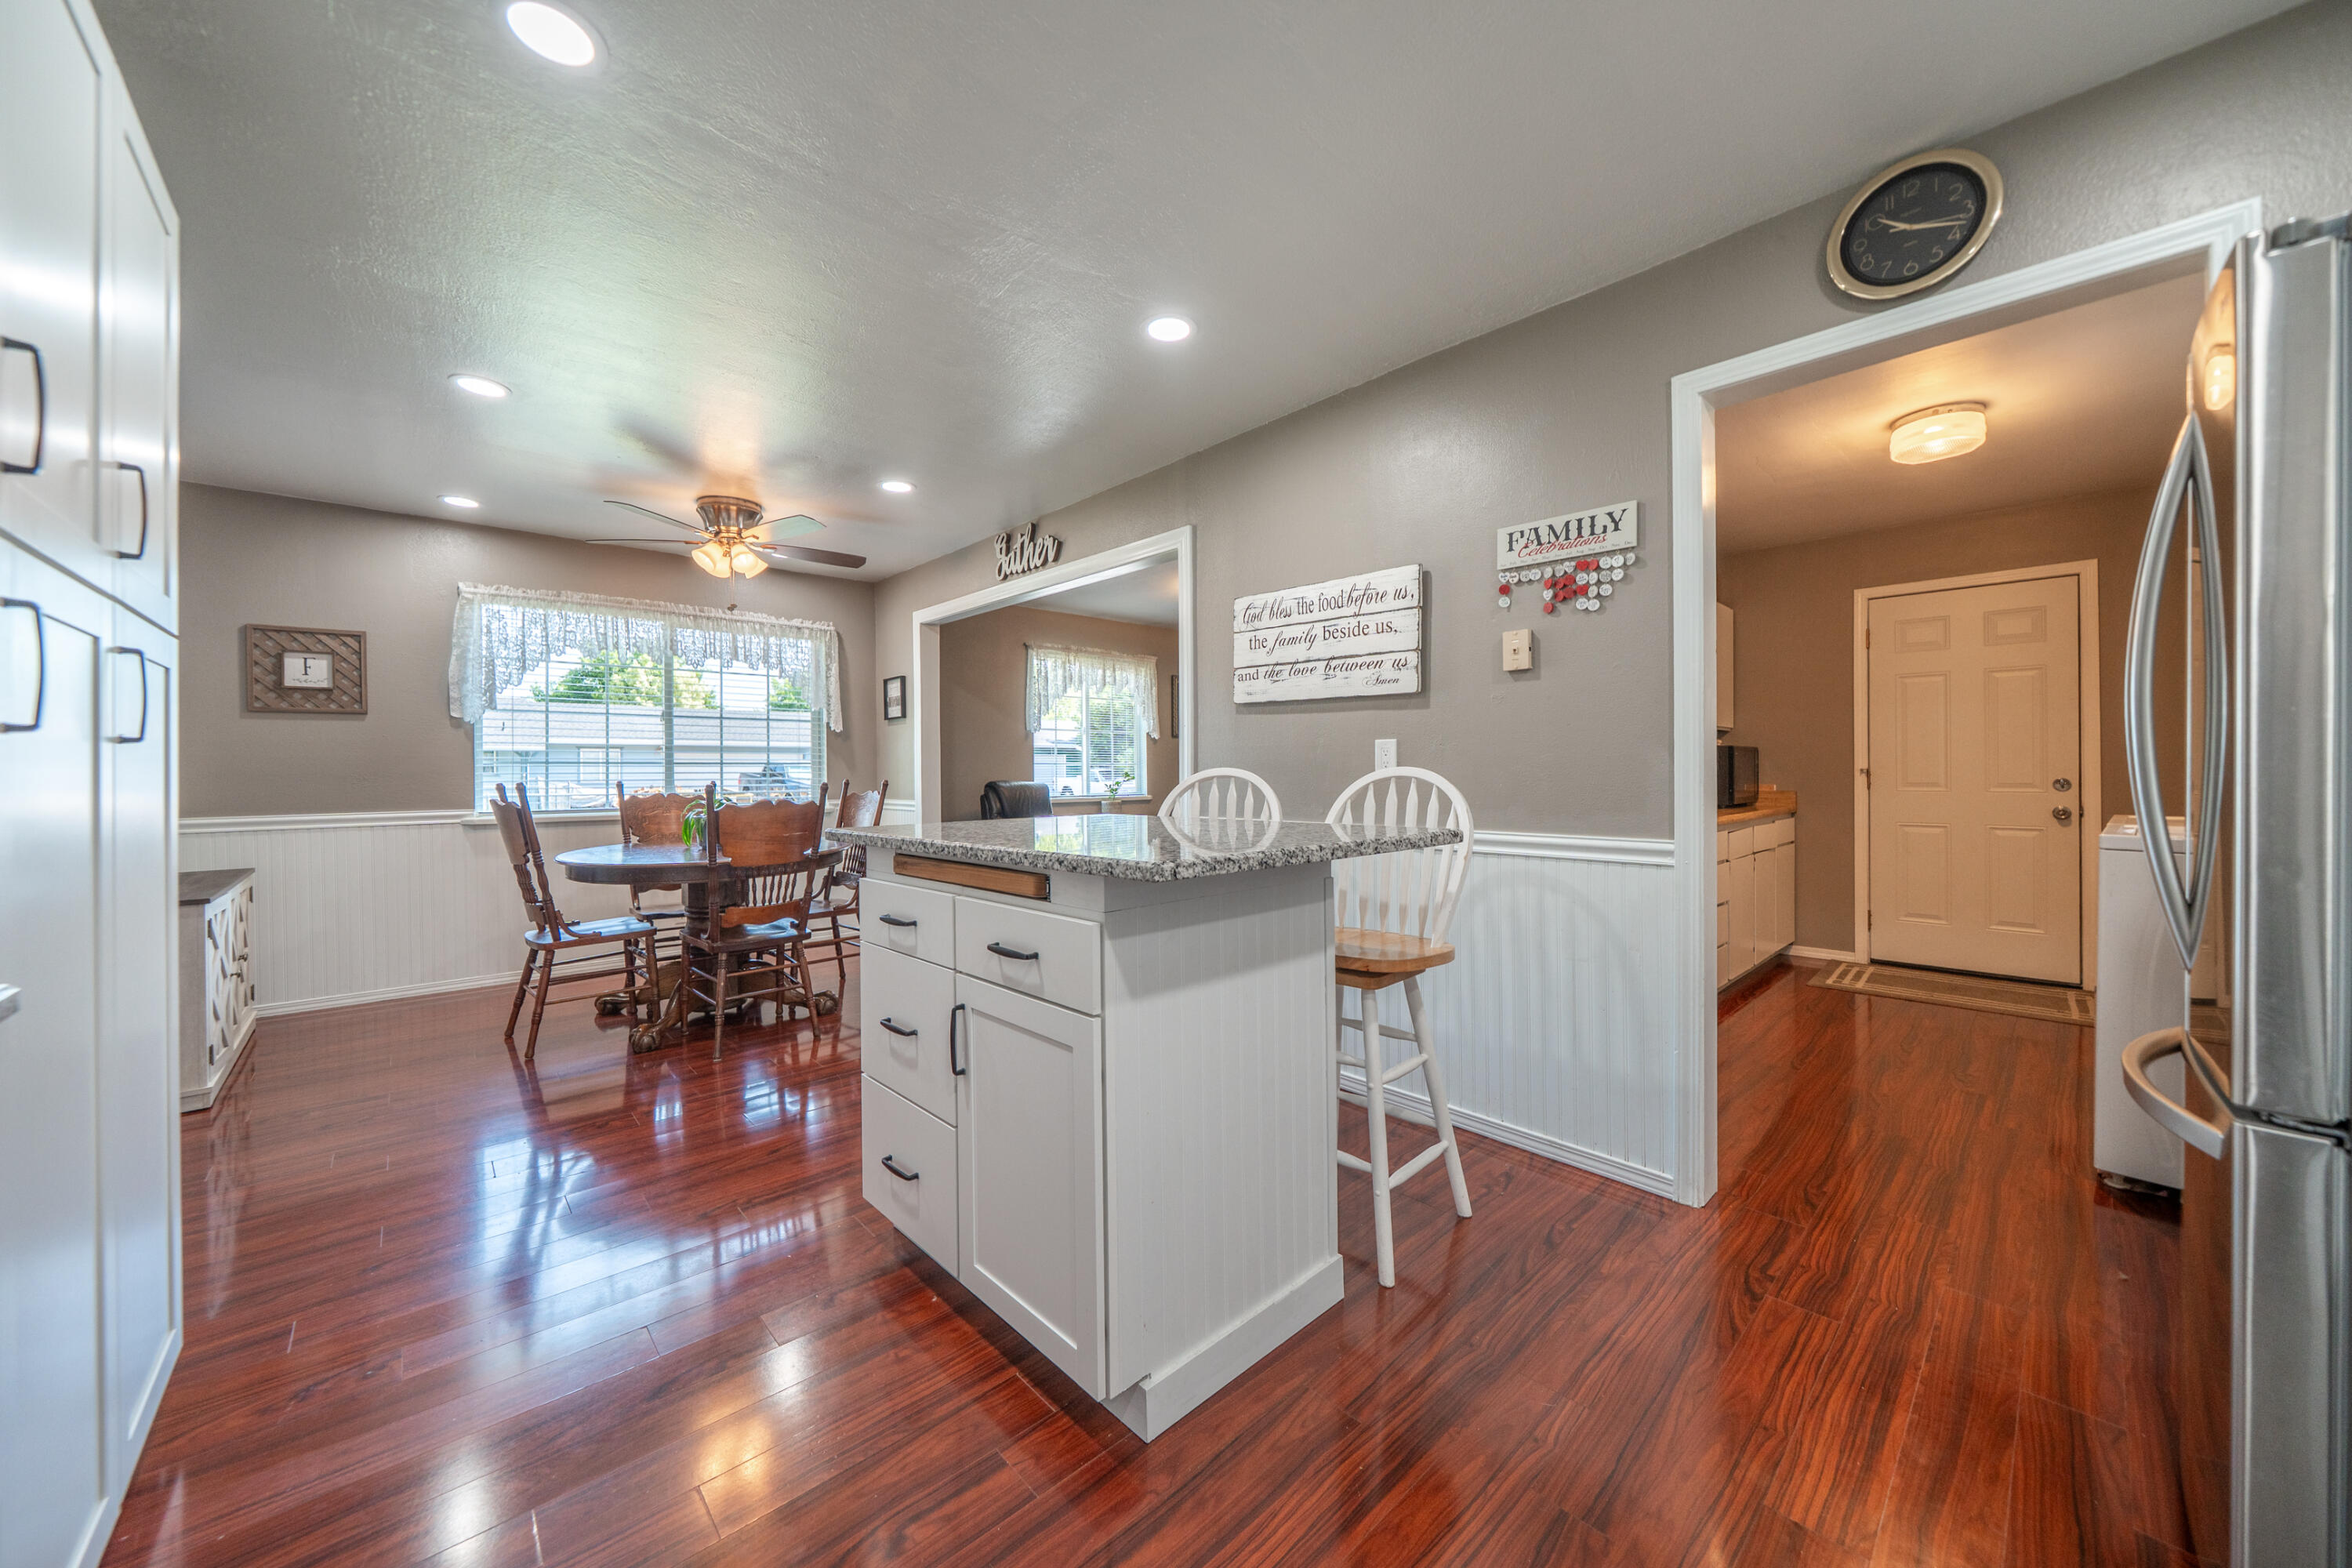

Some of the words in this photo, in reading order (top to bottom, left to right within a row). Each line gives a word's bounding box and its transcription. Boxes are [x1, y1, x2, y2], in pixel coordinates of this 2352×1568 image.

[1903, 180, 1920, 198] 12
[1933, 176, 1939, 193] 1
[1949, 183, 1964, 201] 2
[1885, 194, 1895, 212] 11
[1962, 199, 1976, 219] 3
[1864, 212, 1886, 233] 10
[1947, 223, 1963, 240] 4
[1853, 238, 1867, 253] 9
[1929, 245, 1944, 263] 5
[1860, 252, 1875, 270] 8
[1881, 260, 1893, 278] 7
[1903, 260, 1919, 276] 6
[1506, 507, 1629, 553] FAMILY
[1518, 534, 1607, 558] Celebrations
[1241, 600, 1269, 627] God
[1269, 597, 1293, 621] bless
[1297, 596, 1315, 615] the
[1318, 589, 1344, 612] food
[1346, 582, 1388, 619] before
[1393, 585, 1414, 601] us,
[1249, 634, 1268, 650] the
[1266, 625, 1317, 657] family
[1323, 620, 1370, 641] beside
[1375, 620, 1398, 635] us,
[302, 657, 316, 676] F
[1237, 669, 1259, 682] and
[1263, 661, 1283, 679] the
[1288, 659, 1317, 677] love
[1323, 655, 1384, 673] between
[1392, 656, 1409, 669] us
[1363, 673, 1399, 687] Amen
